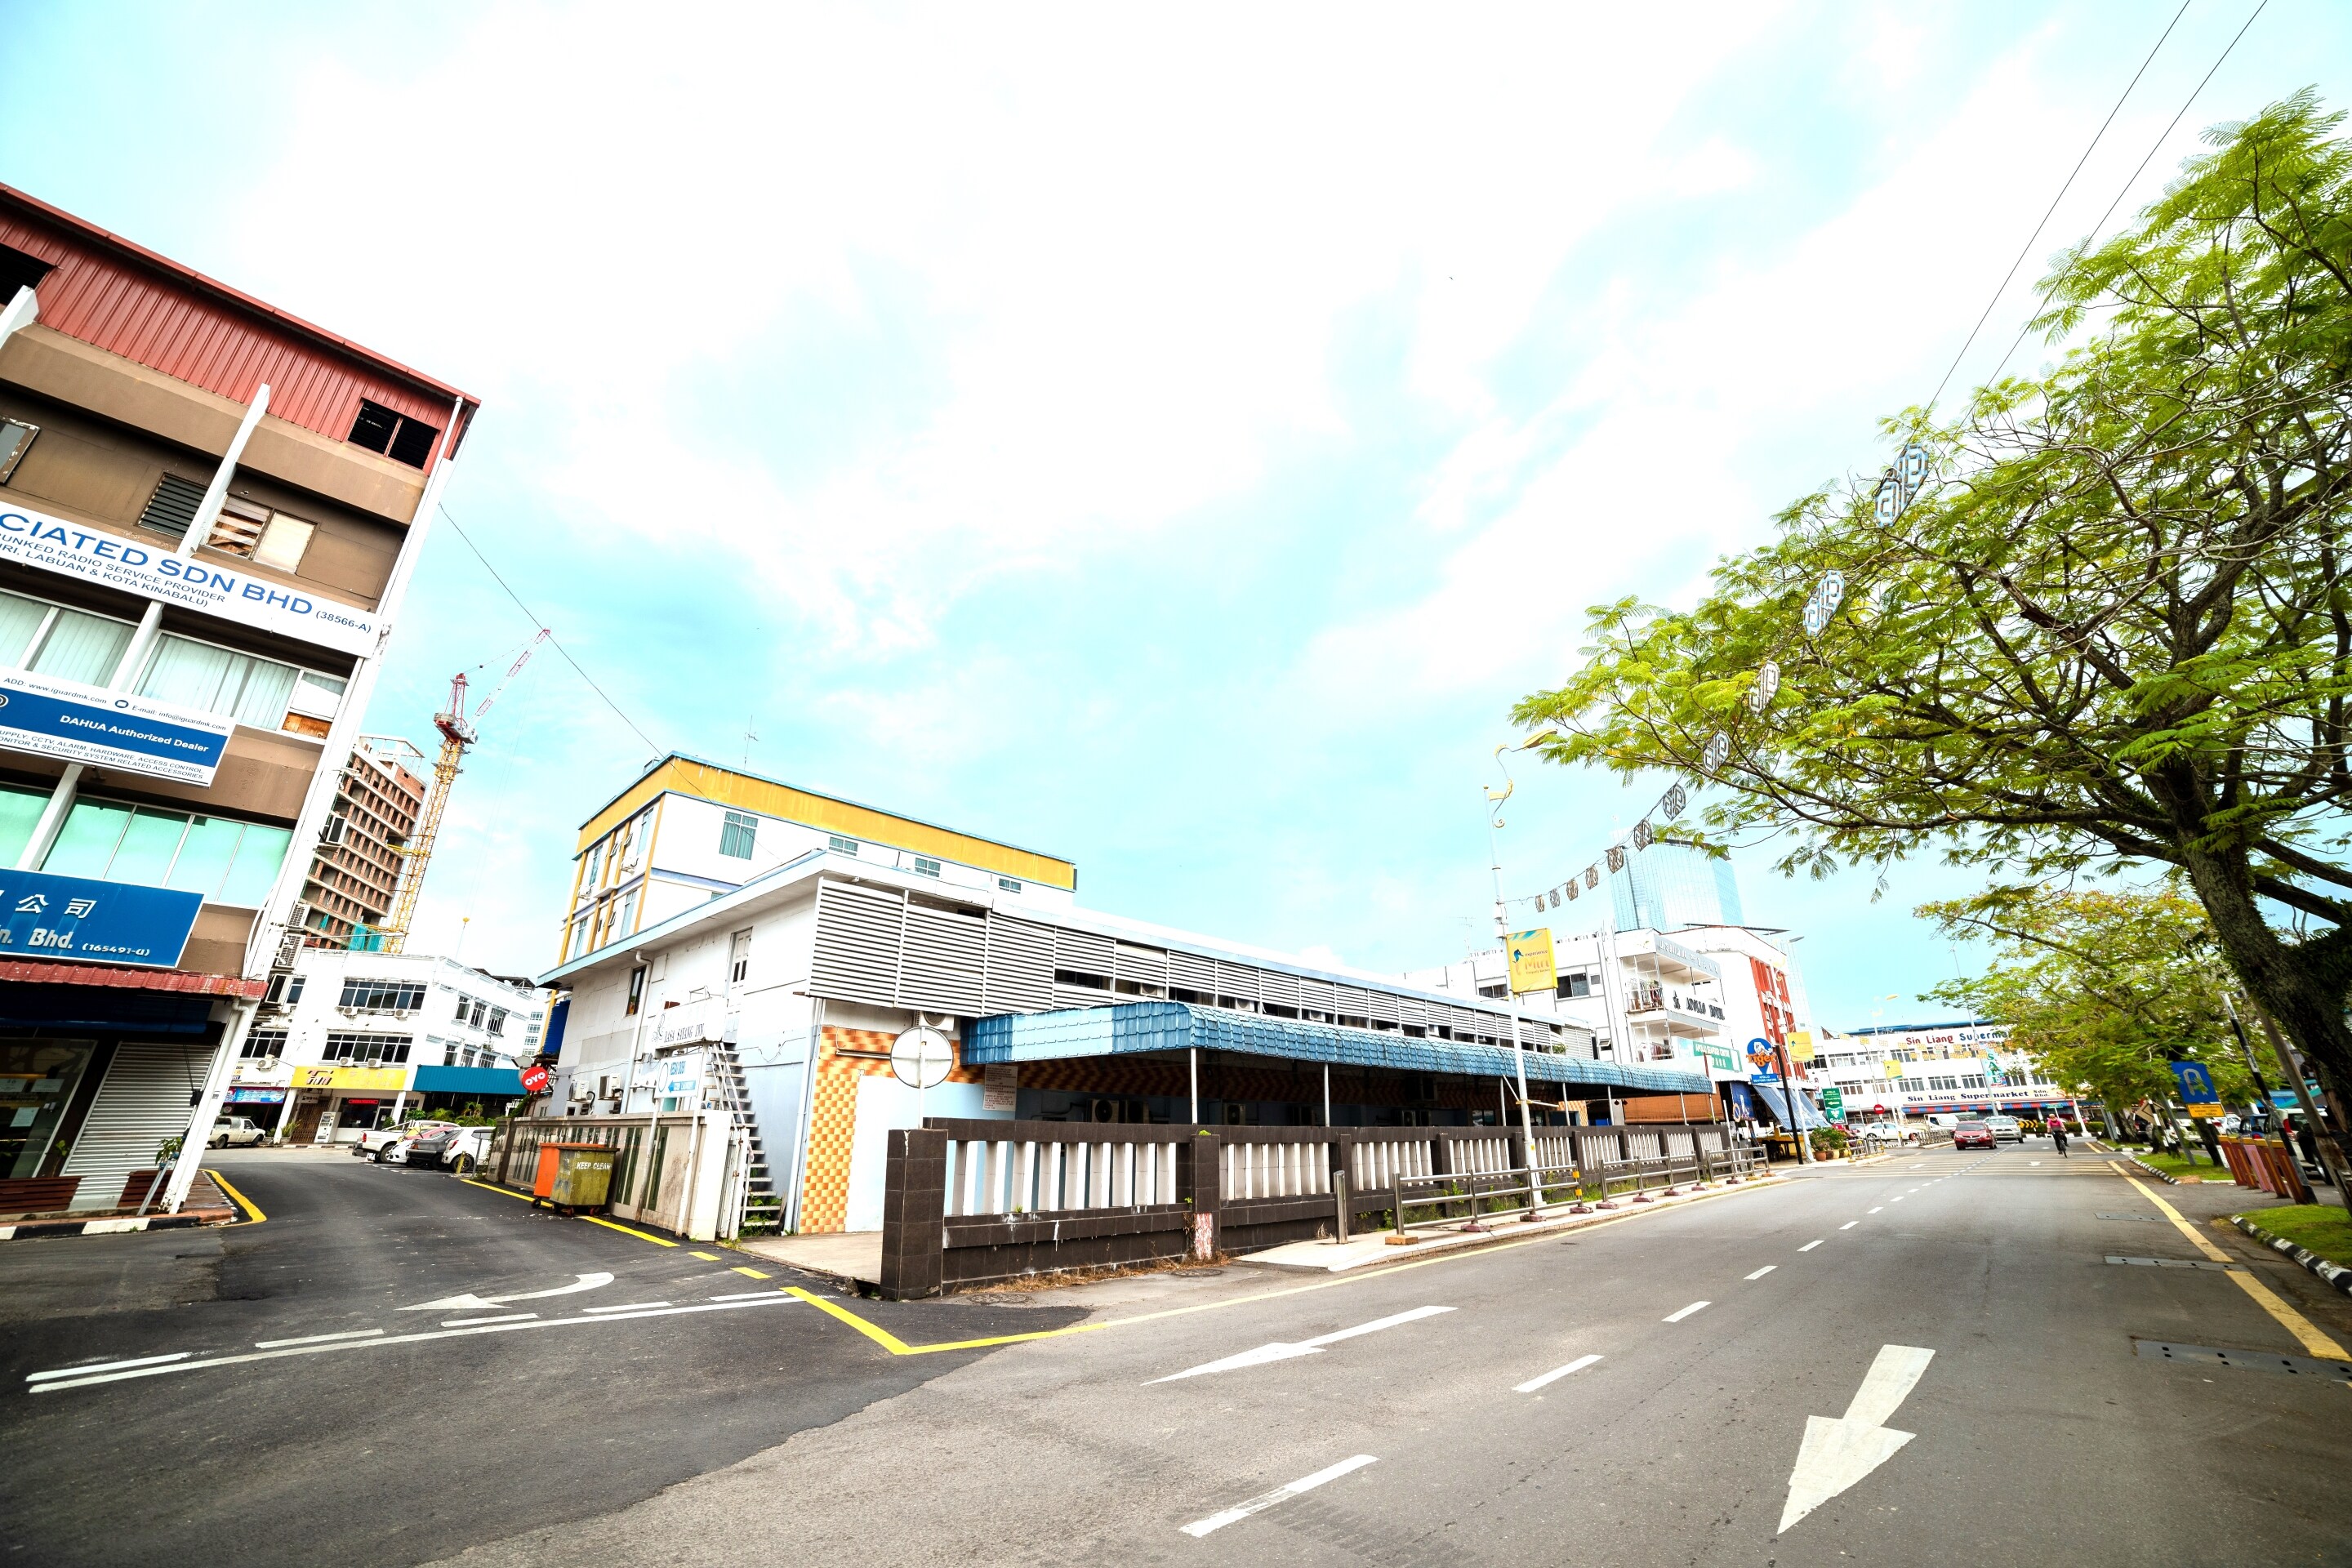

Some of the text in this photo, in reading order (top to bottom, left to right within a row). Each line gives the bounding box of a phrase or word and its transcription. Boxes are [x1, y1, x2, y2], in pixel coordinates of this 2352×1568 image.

[0, 533, 225, 603] UNKED RADIO SERVICE PROVIDER
[25, 550, 87, 572] LABUAN
[89, 568, 99, 577] &
[102, 572, 138, 587] KOTA
[141, 582, 208, 608] KINABALU)
[157, 559, 235, 592] SDN
[242, 583, 313, 614] BHD
[315, 610, 372, 634] (38566-A)
[3, 677, 226, 731] ADD: www.iguardmk.com E-mail: info@iguardmk.com
[60, 715, 209, 752] DAHUA Authorized Dealer
[41, 744, 82, 755] SECURITY
[83, 752, 116, 762] SYSTEM
[117, 757, 152, 769] RELATED
[153, 765, 203, 779] ACCESSORIES
[138, 757, 168, 767] ACCESS
[0, 890, 97, 919] 公司
[28, 928, 74, 949] Bhd.
[1905, 1036, 1921, 1045] Sin
[1926, 1035, 1954, 1044] Liang
[1746, 1051, 1776, 1067] Tiger
[524, 1071, 546, 1086] OYO
[576, 1161, 611, 1170] KEEP CLEAN
